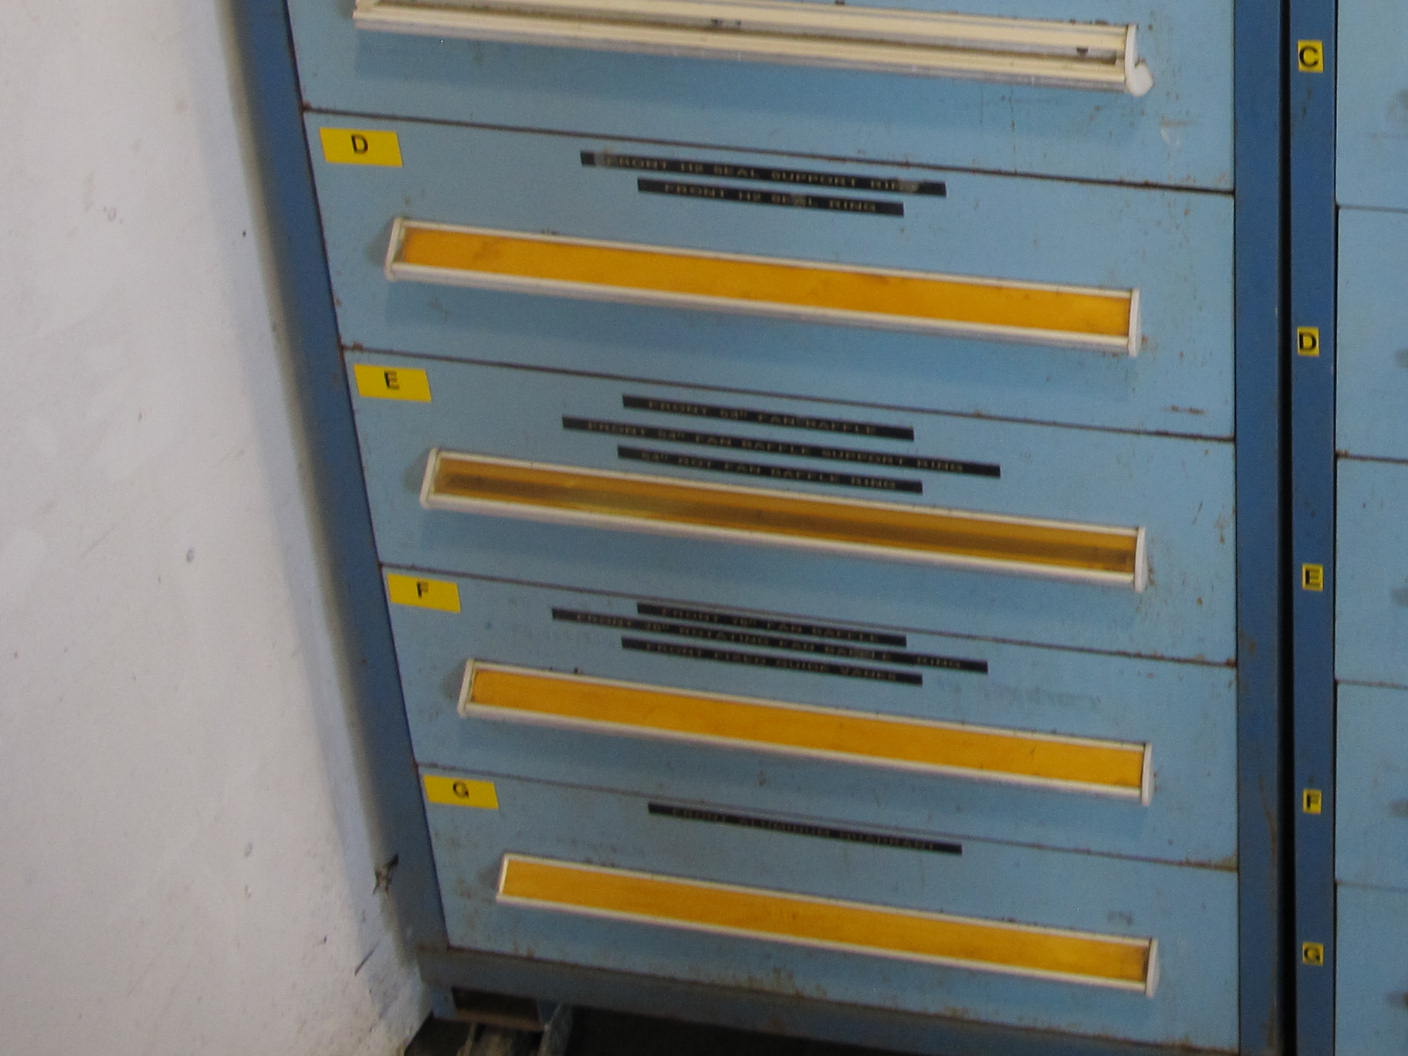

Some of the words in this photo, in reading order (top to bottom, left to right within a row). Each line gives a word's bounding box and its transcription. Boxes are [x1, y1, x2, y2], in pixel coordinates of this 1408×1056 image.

[1299, 45, 1319, 68] C
[349, 134, 369, 154] D
[1298, 334, 1317, 352] D
[383, 371, 399, 390] E
[1305, 567, 1321, 587] E
[415, 581, 430, 598] F
[452, 781, 471, 798] G
[1305, 793, 1320, 810] F
[1303, 945, 1322, 962] G
